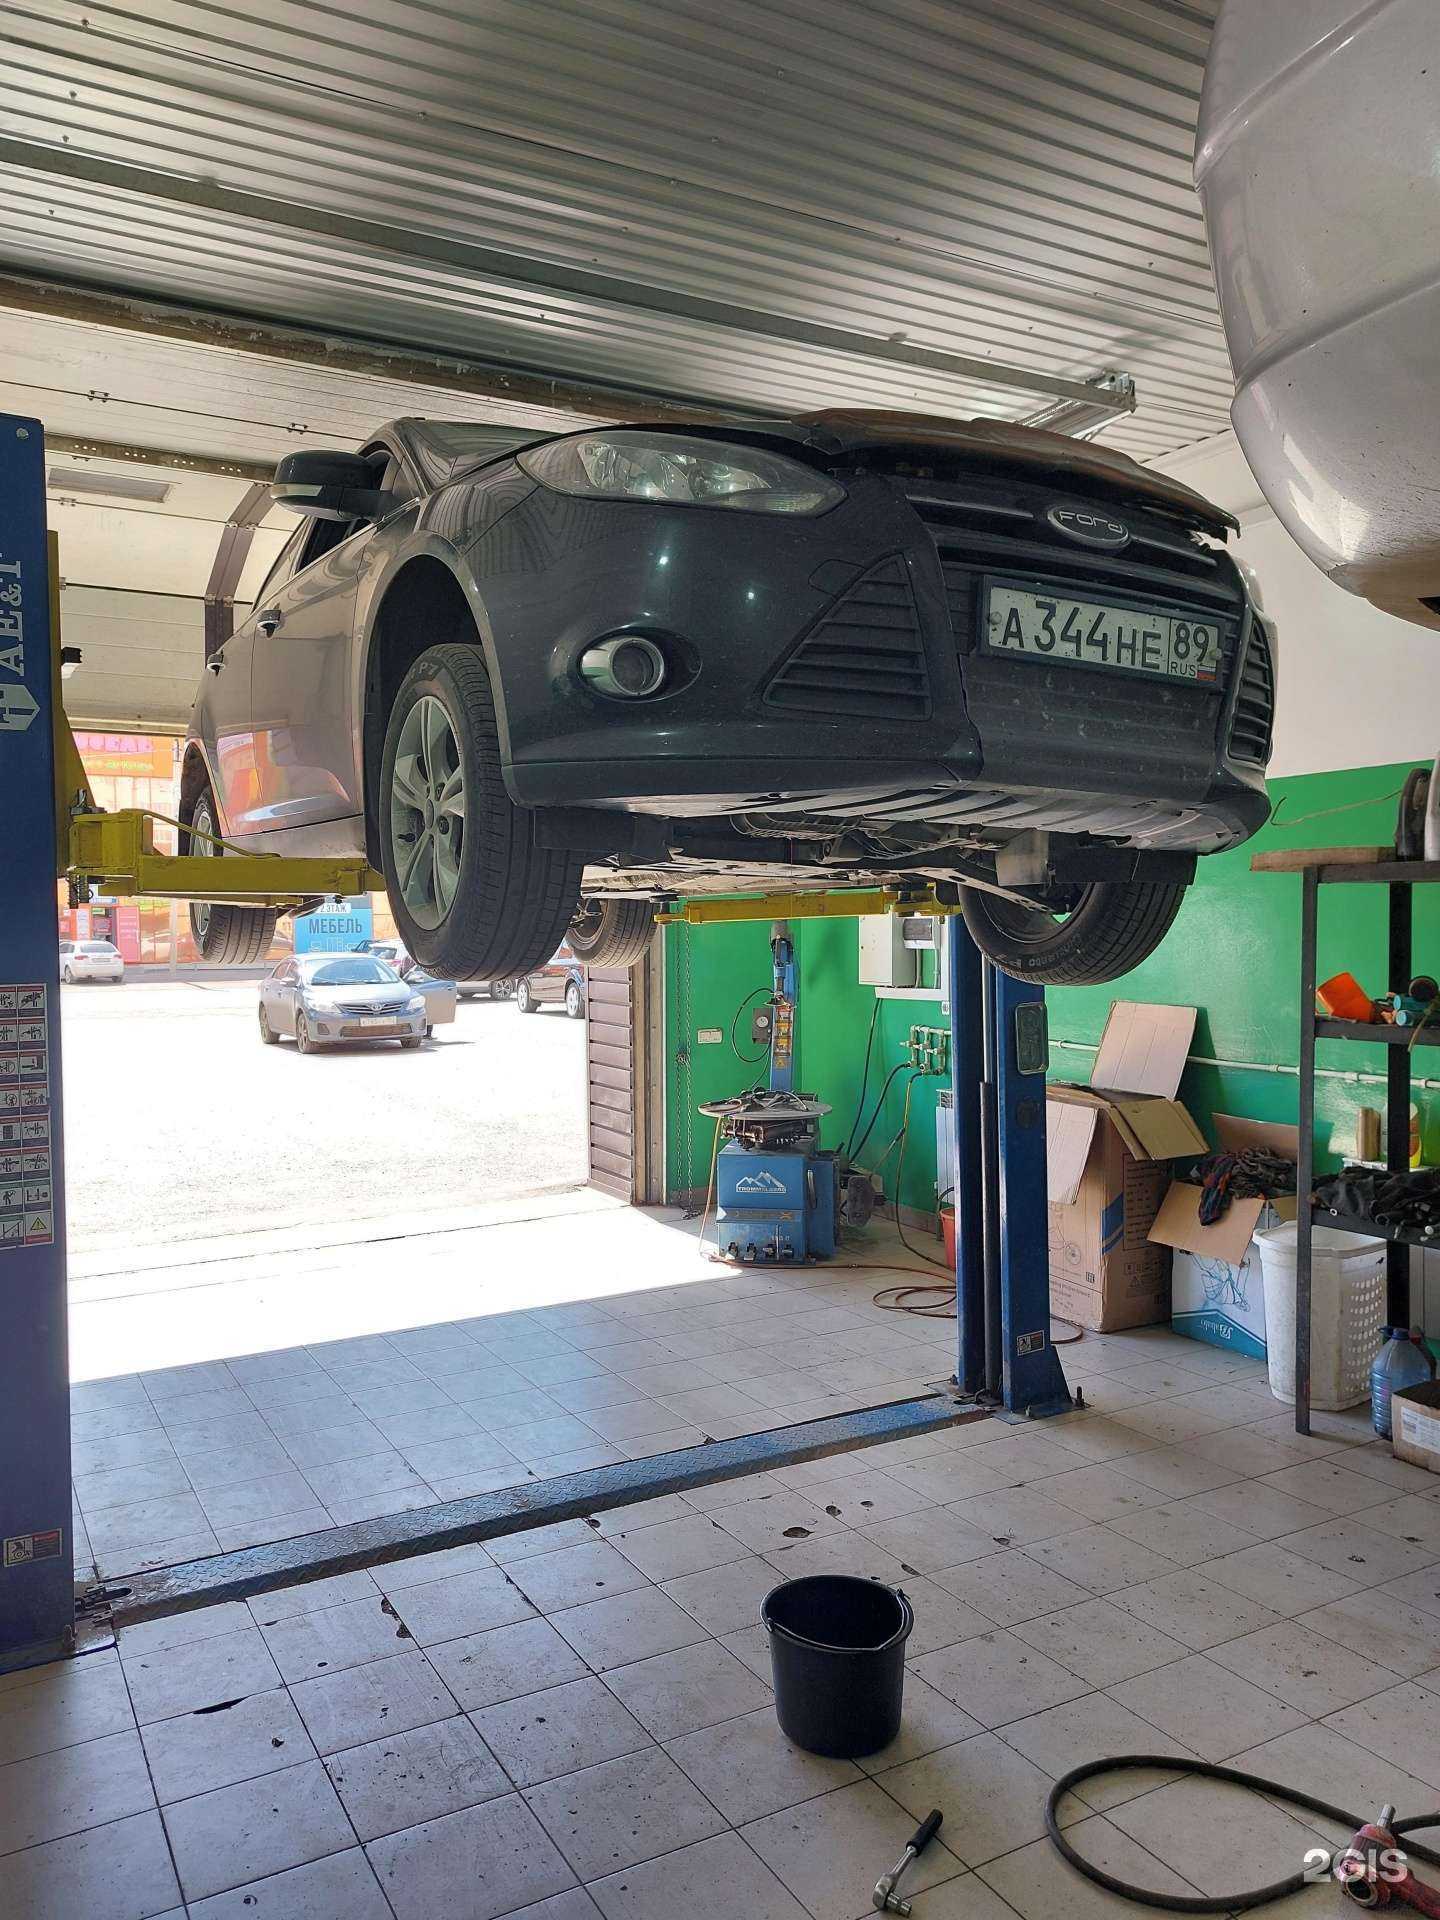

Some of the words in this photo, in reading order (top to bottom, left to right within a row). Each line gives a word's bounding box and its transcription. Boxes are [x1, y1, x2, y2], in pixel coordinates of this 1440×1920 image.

[1173, 622, 1211, 663] 89
[1170, 661, 1198, 678] RUS
[326, 903, 347, 913] ЭТАЖ
[309, 918, 363, 934] МЕБЕЛЬ
